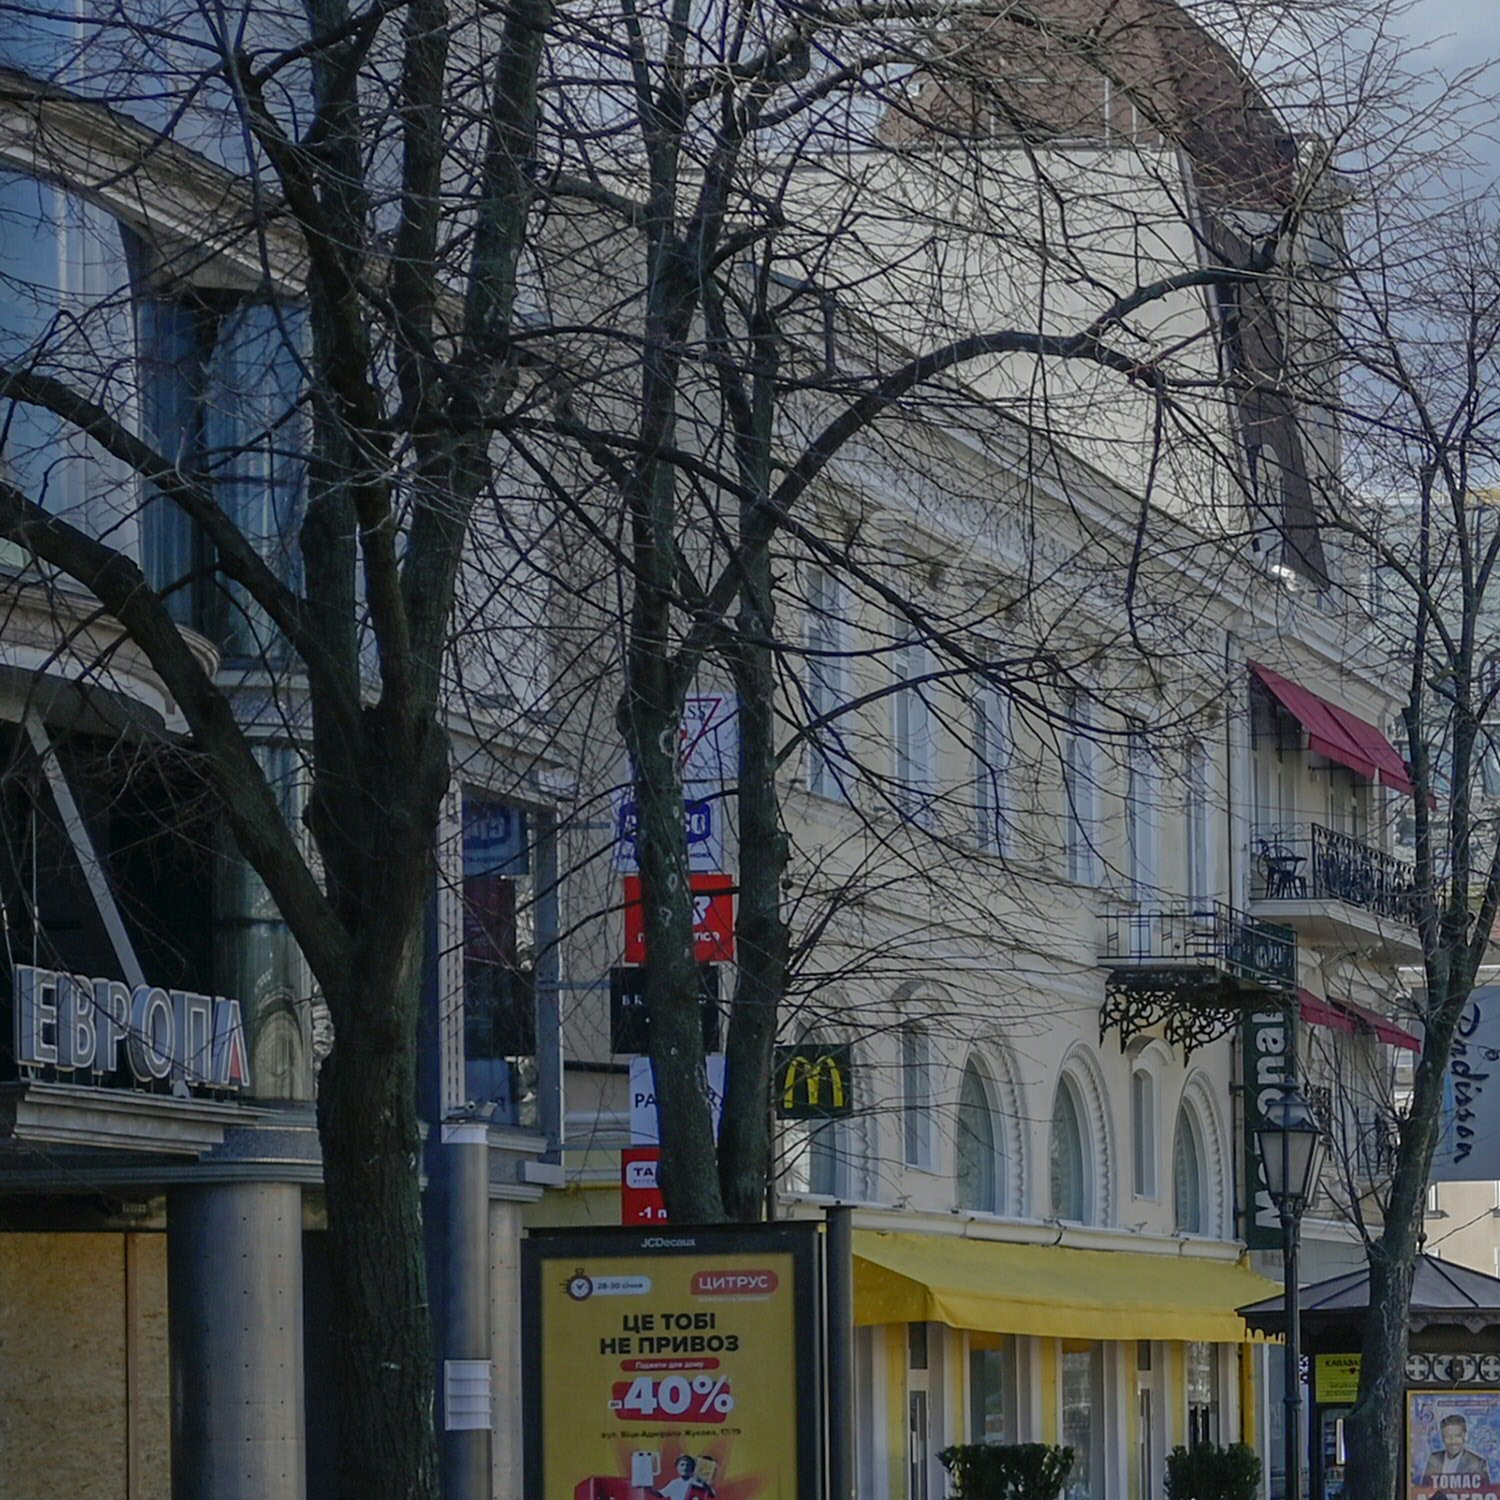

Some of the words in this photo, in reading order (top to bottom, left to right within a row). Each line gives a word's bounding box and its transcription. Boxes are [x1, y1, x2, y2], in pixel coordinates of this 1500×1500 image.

[640, 1237, 696, 1248] JCDecaux
[698, 1275, 768, 1290] ЦИТРУС
[622, 1314, 653, 1334] ЦЕ
[660, 1313, 716, 1331] ТОБІ
[600, 1337, 631, 1355] НЕ
[639, 1335, 740, 1354] ПРИВОЗ
[1431, 1474, 1481, 1489] ТОМАС
